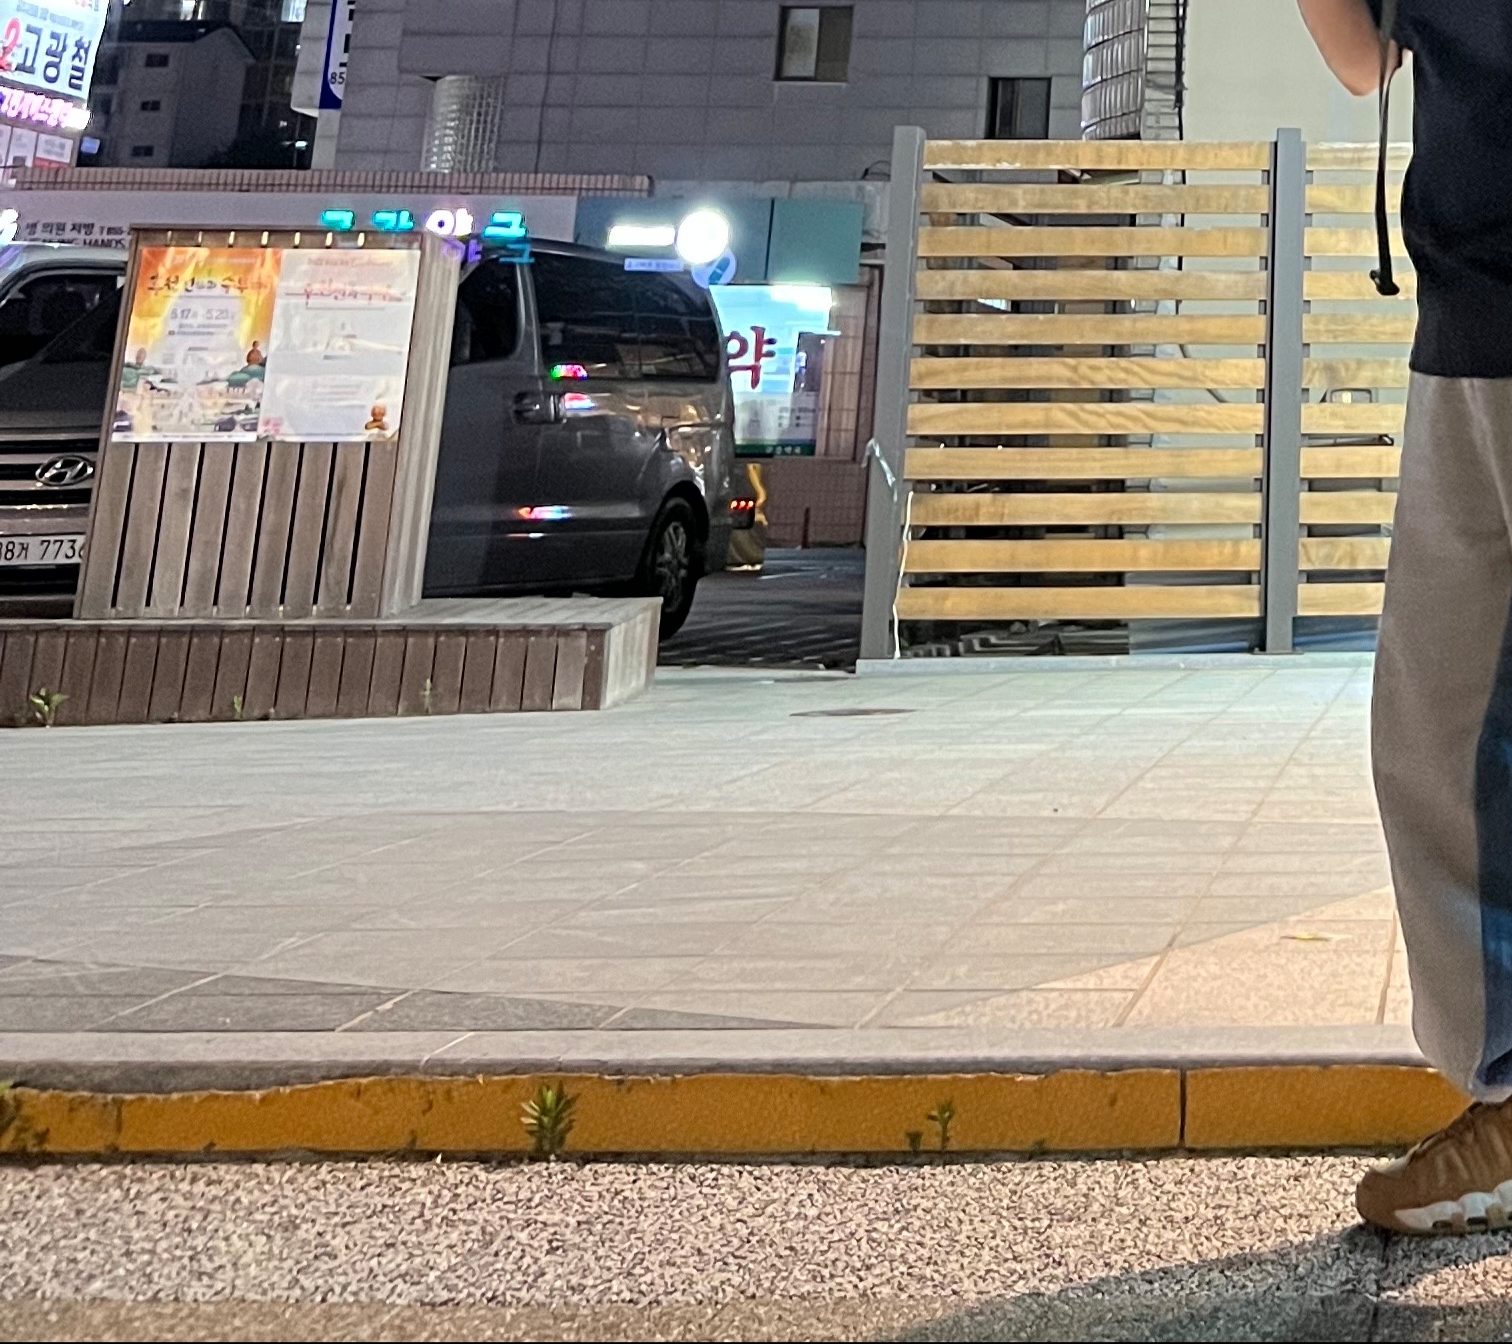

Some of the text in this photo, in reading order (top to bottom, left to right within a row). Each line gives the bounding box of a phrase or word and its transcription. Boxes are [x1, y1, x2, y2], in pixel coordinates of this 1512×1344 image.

[15, 23, 93, 92] 고광철
[725, 325, 777, 390] 약
[0, 540, 29, 562] 8거
